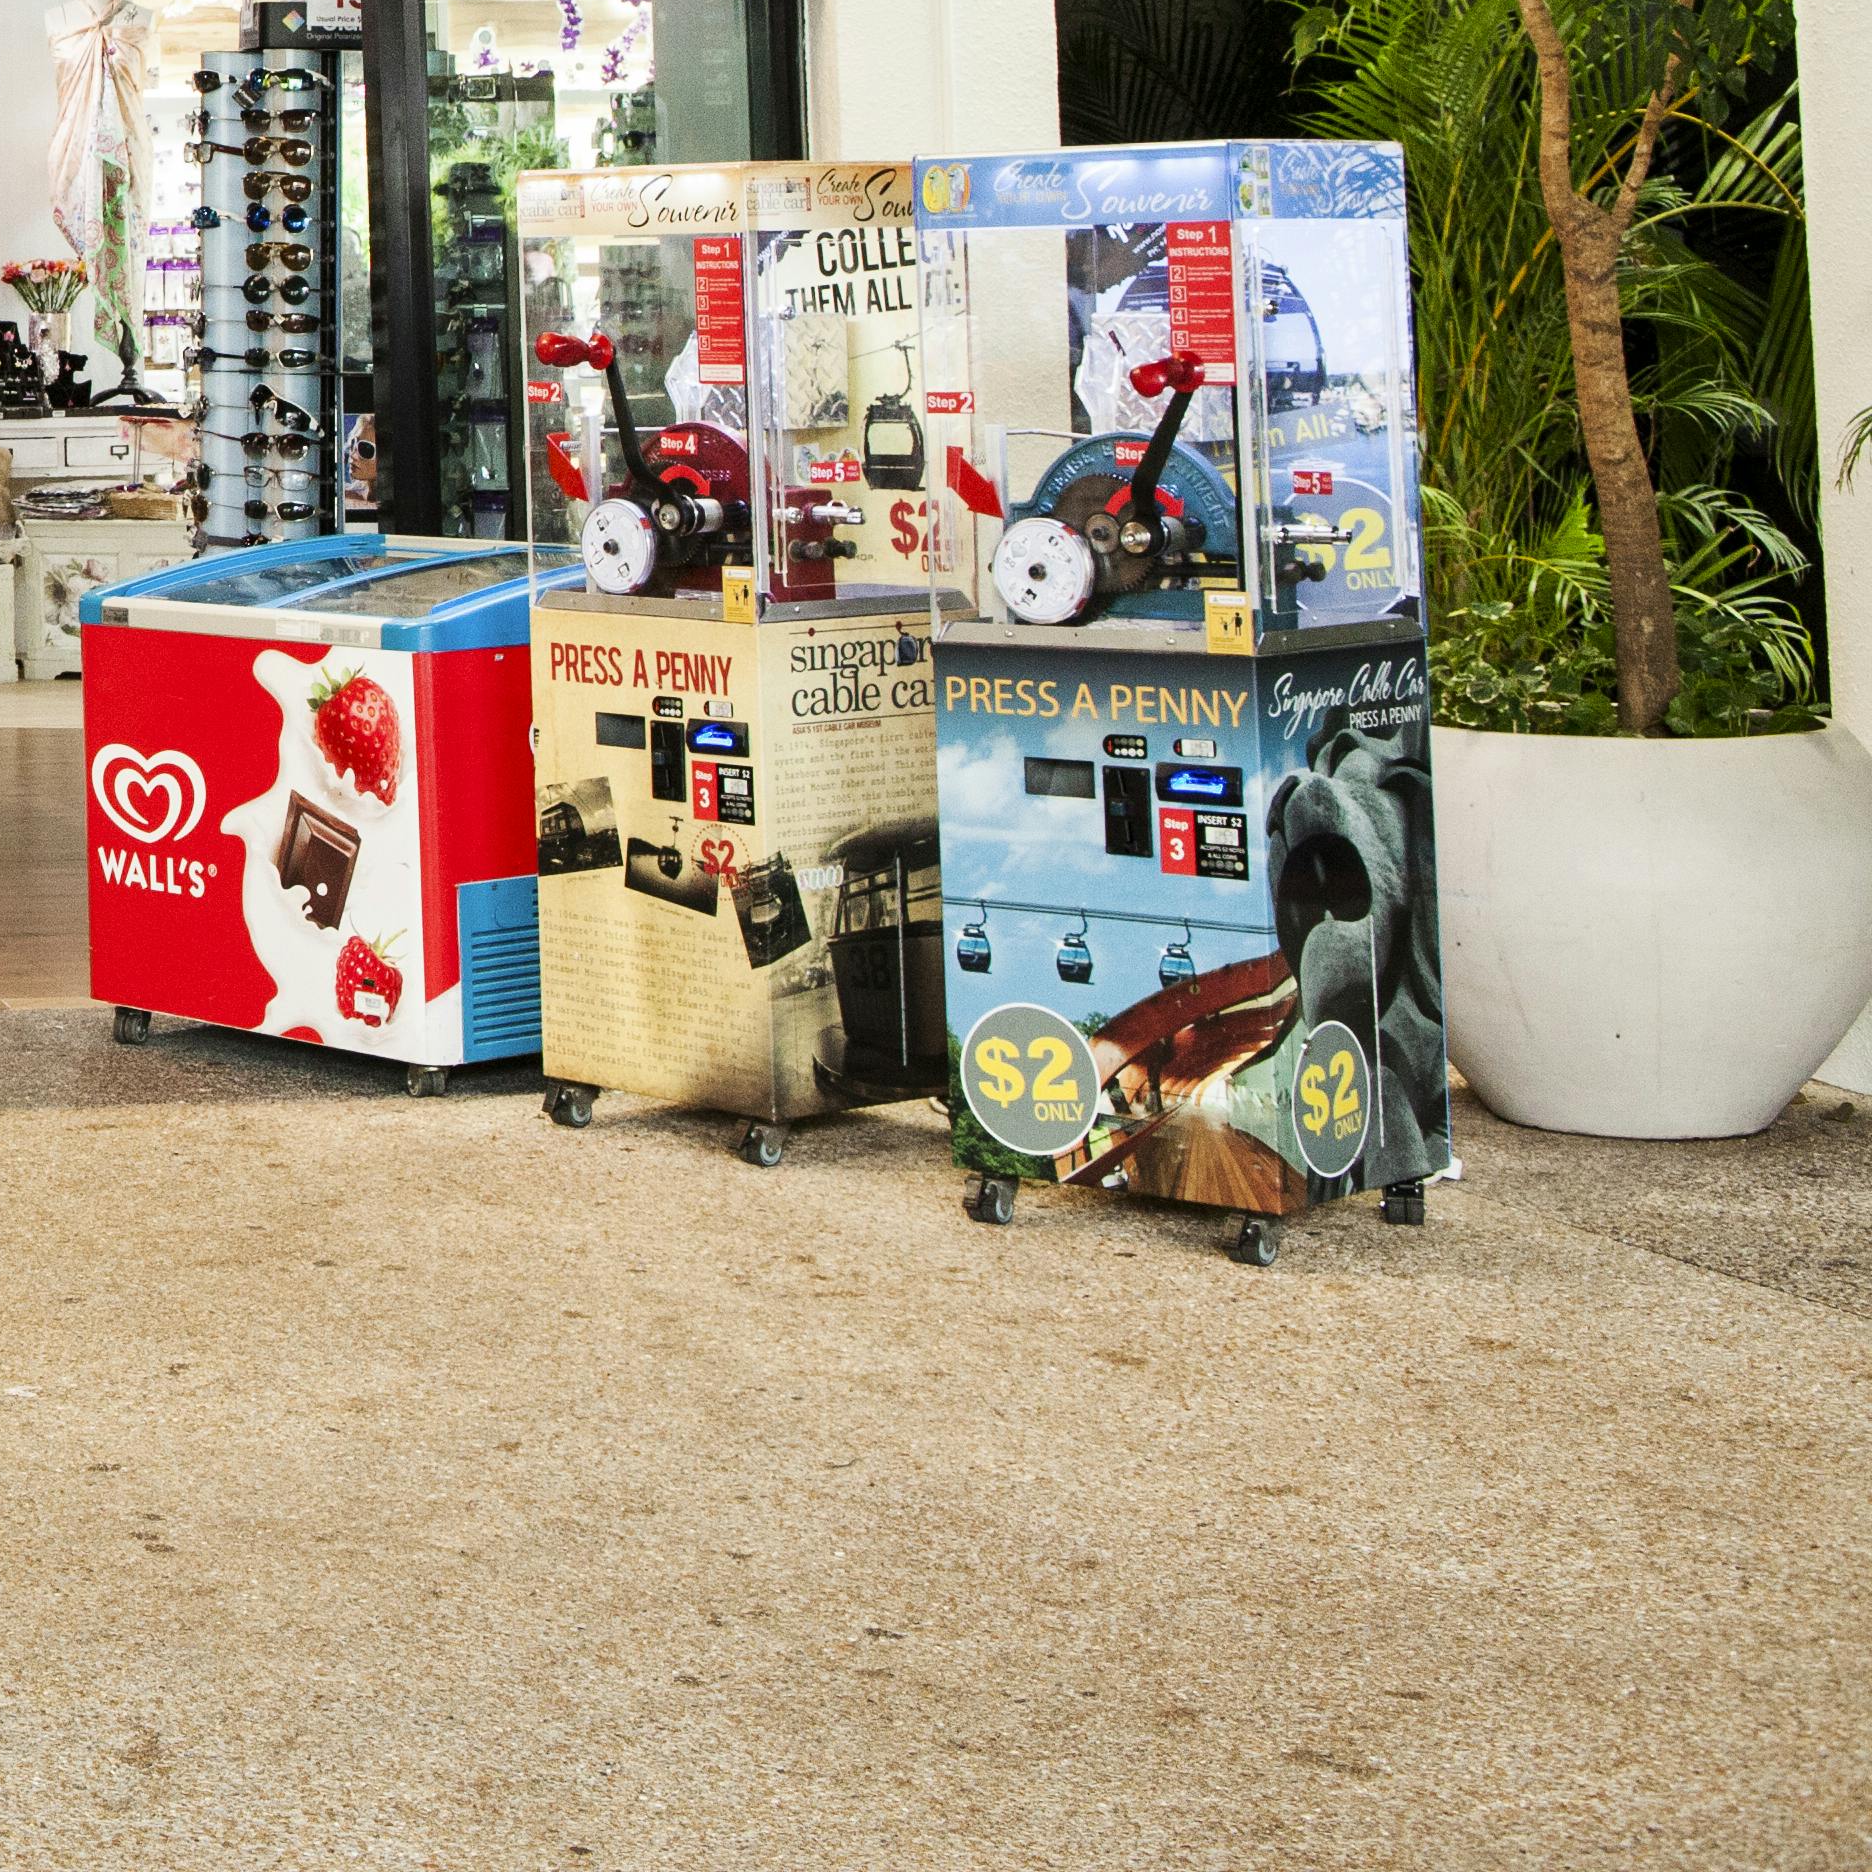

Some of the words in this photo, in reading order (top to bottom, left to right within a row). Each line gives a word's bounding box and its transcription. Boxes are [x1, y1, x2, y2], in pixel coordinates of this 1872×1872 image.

[817, 168, 861, 195] Create
[993, 160, 1064, 193] Create
[628, 175, 739, 227] Souvenir
[818, 195, 840, 205] YOUR
[843, 194, 864, 205] OWN
[1061, 164, 1213, 219] Souvenir
[592, 202, 614, 212] YOUR
[617, 201, 638, 212] OWN
[1177, 229, 1203, 242] Step
[1208, 225, 1216, 243] 1
[701, 244, 721, 255] Step
[724, 242, 730, 257] 1
[816, 228, 916, 277] COLLE
[1169, 247, 1229, 256] INSTRUCTIONS
[867, 276, 912, 314] ALL
[528, 386, 548, 398] Step
[551, 383, 560, 401] 2
[928, 398, 957, 410] Step
[960, 393, 973, 412] 2
[661, 437, 682, 451] Step
[684, 435, 695, 454] 4
[811, 467, 833, 480] Step
[834, 462, 845, 481] 5
[1312, 473, 1320, 494] 5
[551, 643, 623, 686] PRESS
[633, 648, 649, 688] A
[656, 650, 732, 696] PENNY
[791, 636, 933, 679] singapor
[792, 672, 881, 717] cable
[891, 679, 935, 708] ca
[945, 677, 1060, 719] PRESS
[1072, 682, 1099, 720] A
[1111, 684, 1249, 729] PENNY
[1268, 672, 1345, 740] Singapore
[1348, 660, 1392, 707] Cable
[1395, 657, 1424, 701] Car
[1349, 710, 1378, 729] PRESS
[1381, 708, 1389, 725] A
[1389, 704, 1422, 724] PENNY
[700, 788, 710, 808] 3
[1164, 817, 1189, 832] Step
[1197, 815, 1227, 825] INSERT
[1231, 817, 1242, 827] $2
[701, 839, 737, 876] $2
[1170, 838, 1184, 861] 3
[99, 846, 205, 898] WALL'S
[974, 1035, 1079, 1108] $2
[1300, 1050, 1360, 1136] $2
[1034, 1100, 1086, 1123] ONLY
[1335, 1110, 1362, 1140] ONLY
